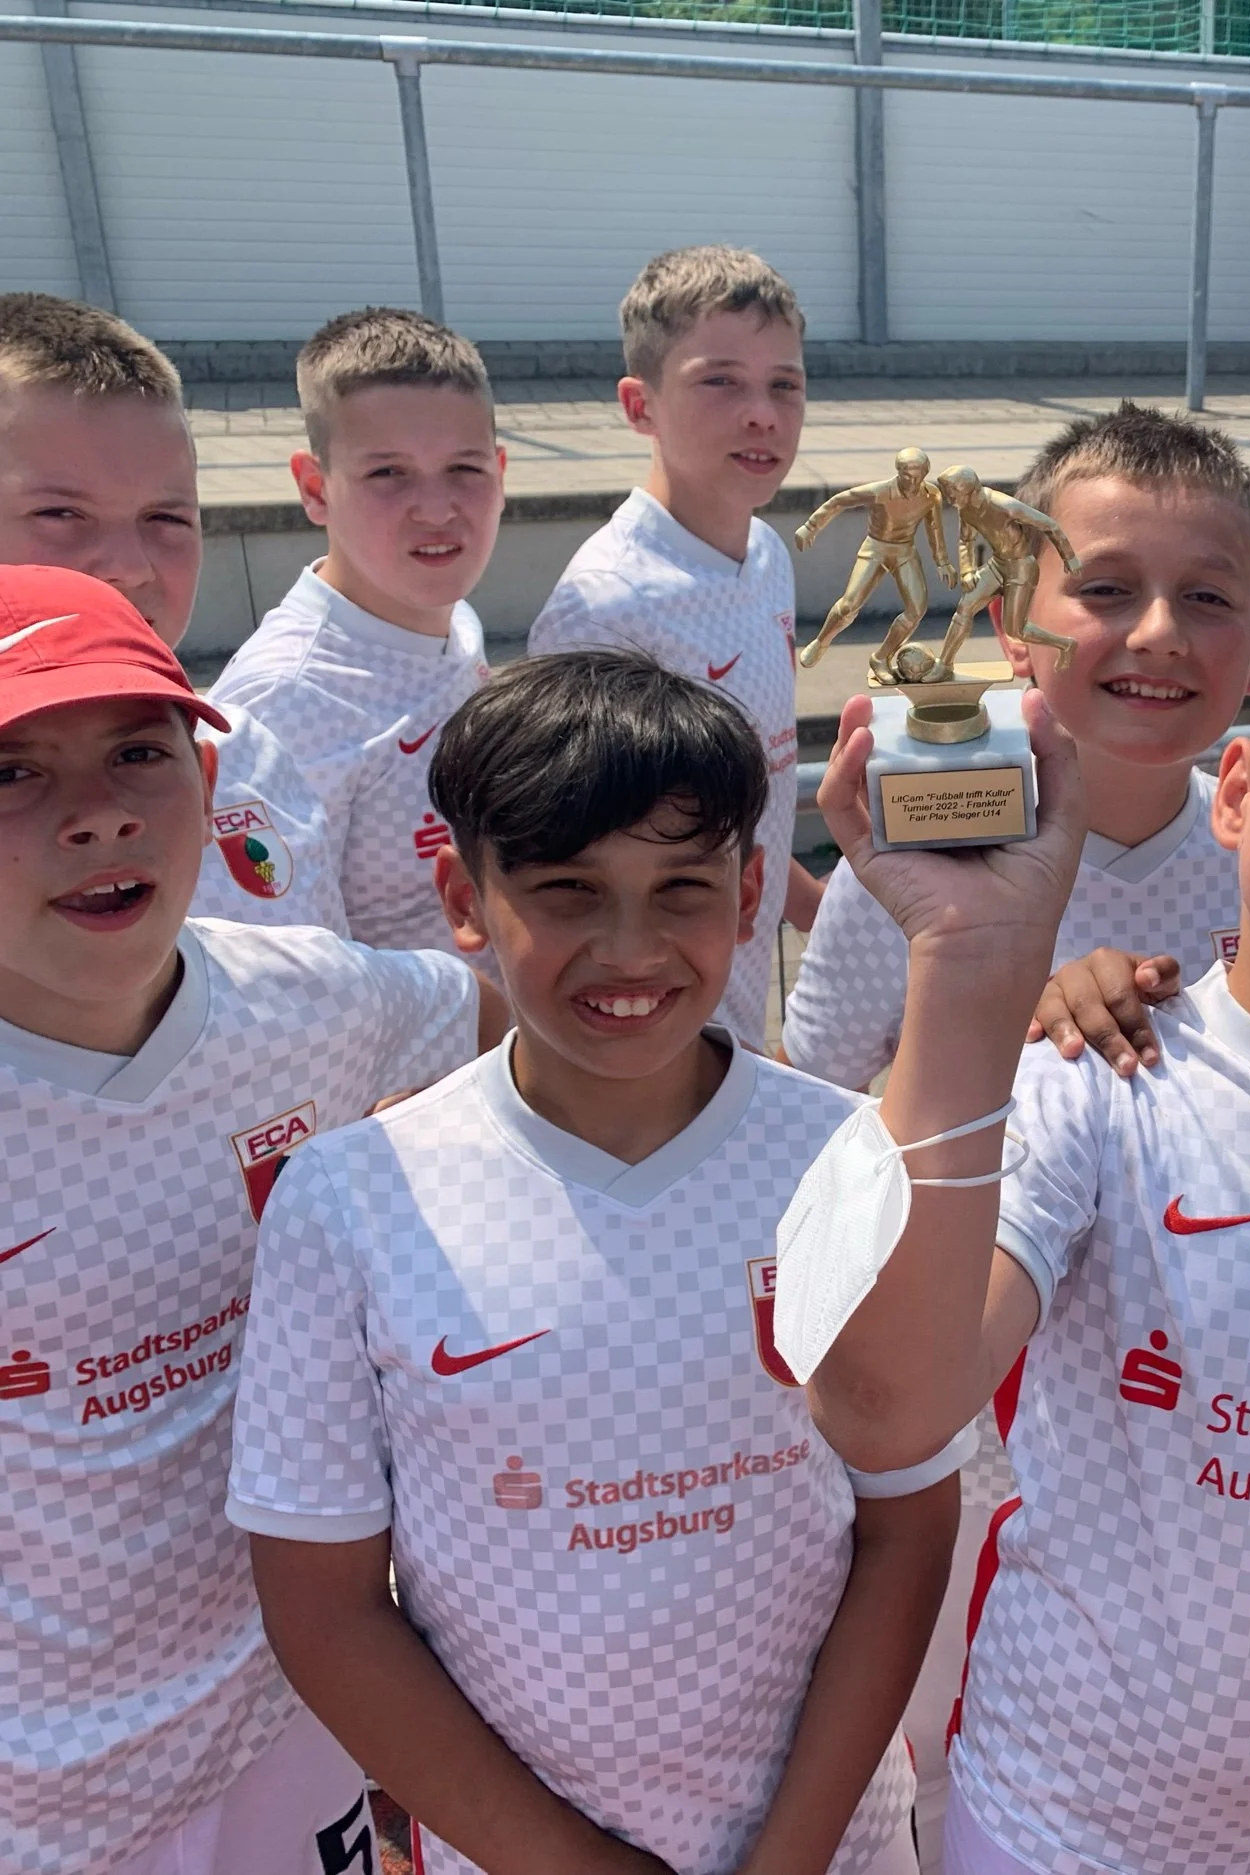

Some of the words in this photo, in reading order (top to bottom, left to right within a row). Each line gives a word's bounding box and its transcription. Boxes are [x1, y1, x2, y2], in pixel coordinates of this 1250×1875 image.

[891, 794, 924, 804] LitCam
[902, 803, 934, 813] Turnier
[936, 802, 958, 811] 2022
[966, 799, 1007, 809] Frankfurt
[909, 813, 926, 822] Fair
[929, 812, 949, 822] Play
[951, 810, 981, 821] Sieger
[982, 809, 1001, 818] U14
[246, 1115, 311, 1160] FCA
[80, 1342, 233, 1426] Augsburg
[564, 1438, 811, 1509] Stadtsparkasse
[566, 1502, 736, 1554] Augsburg
